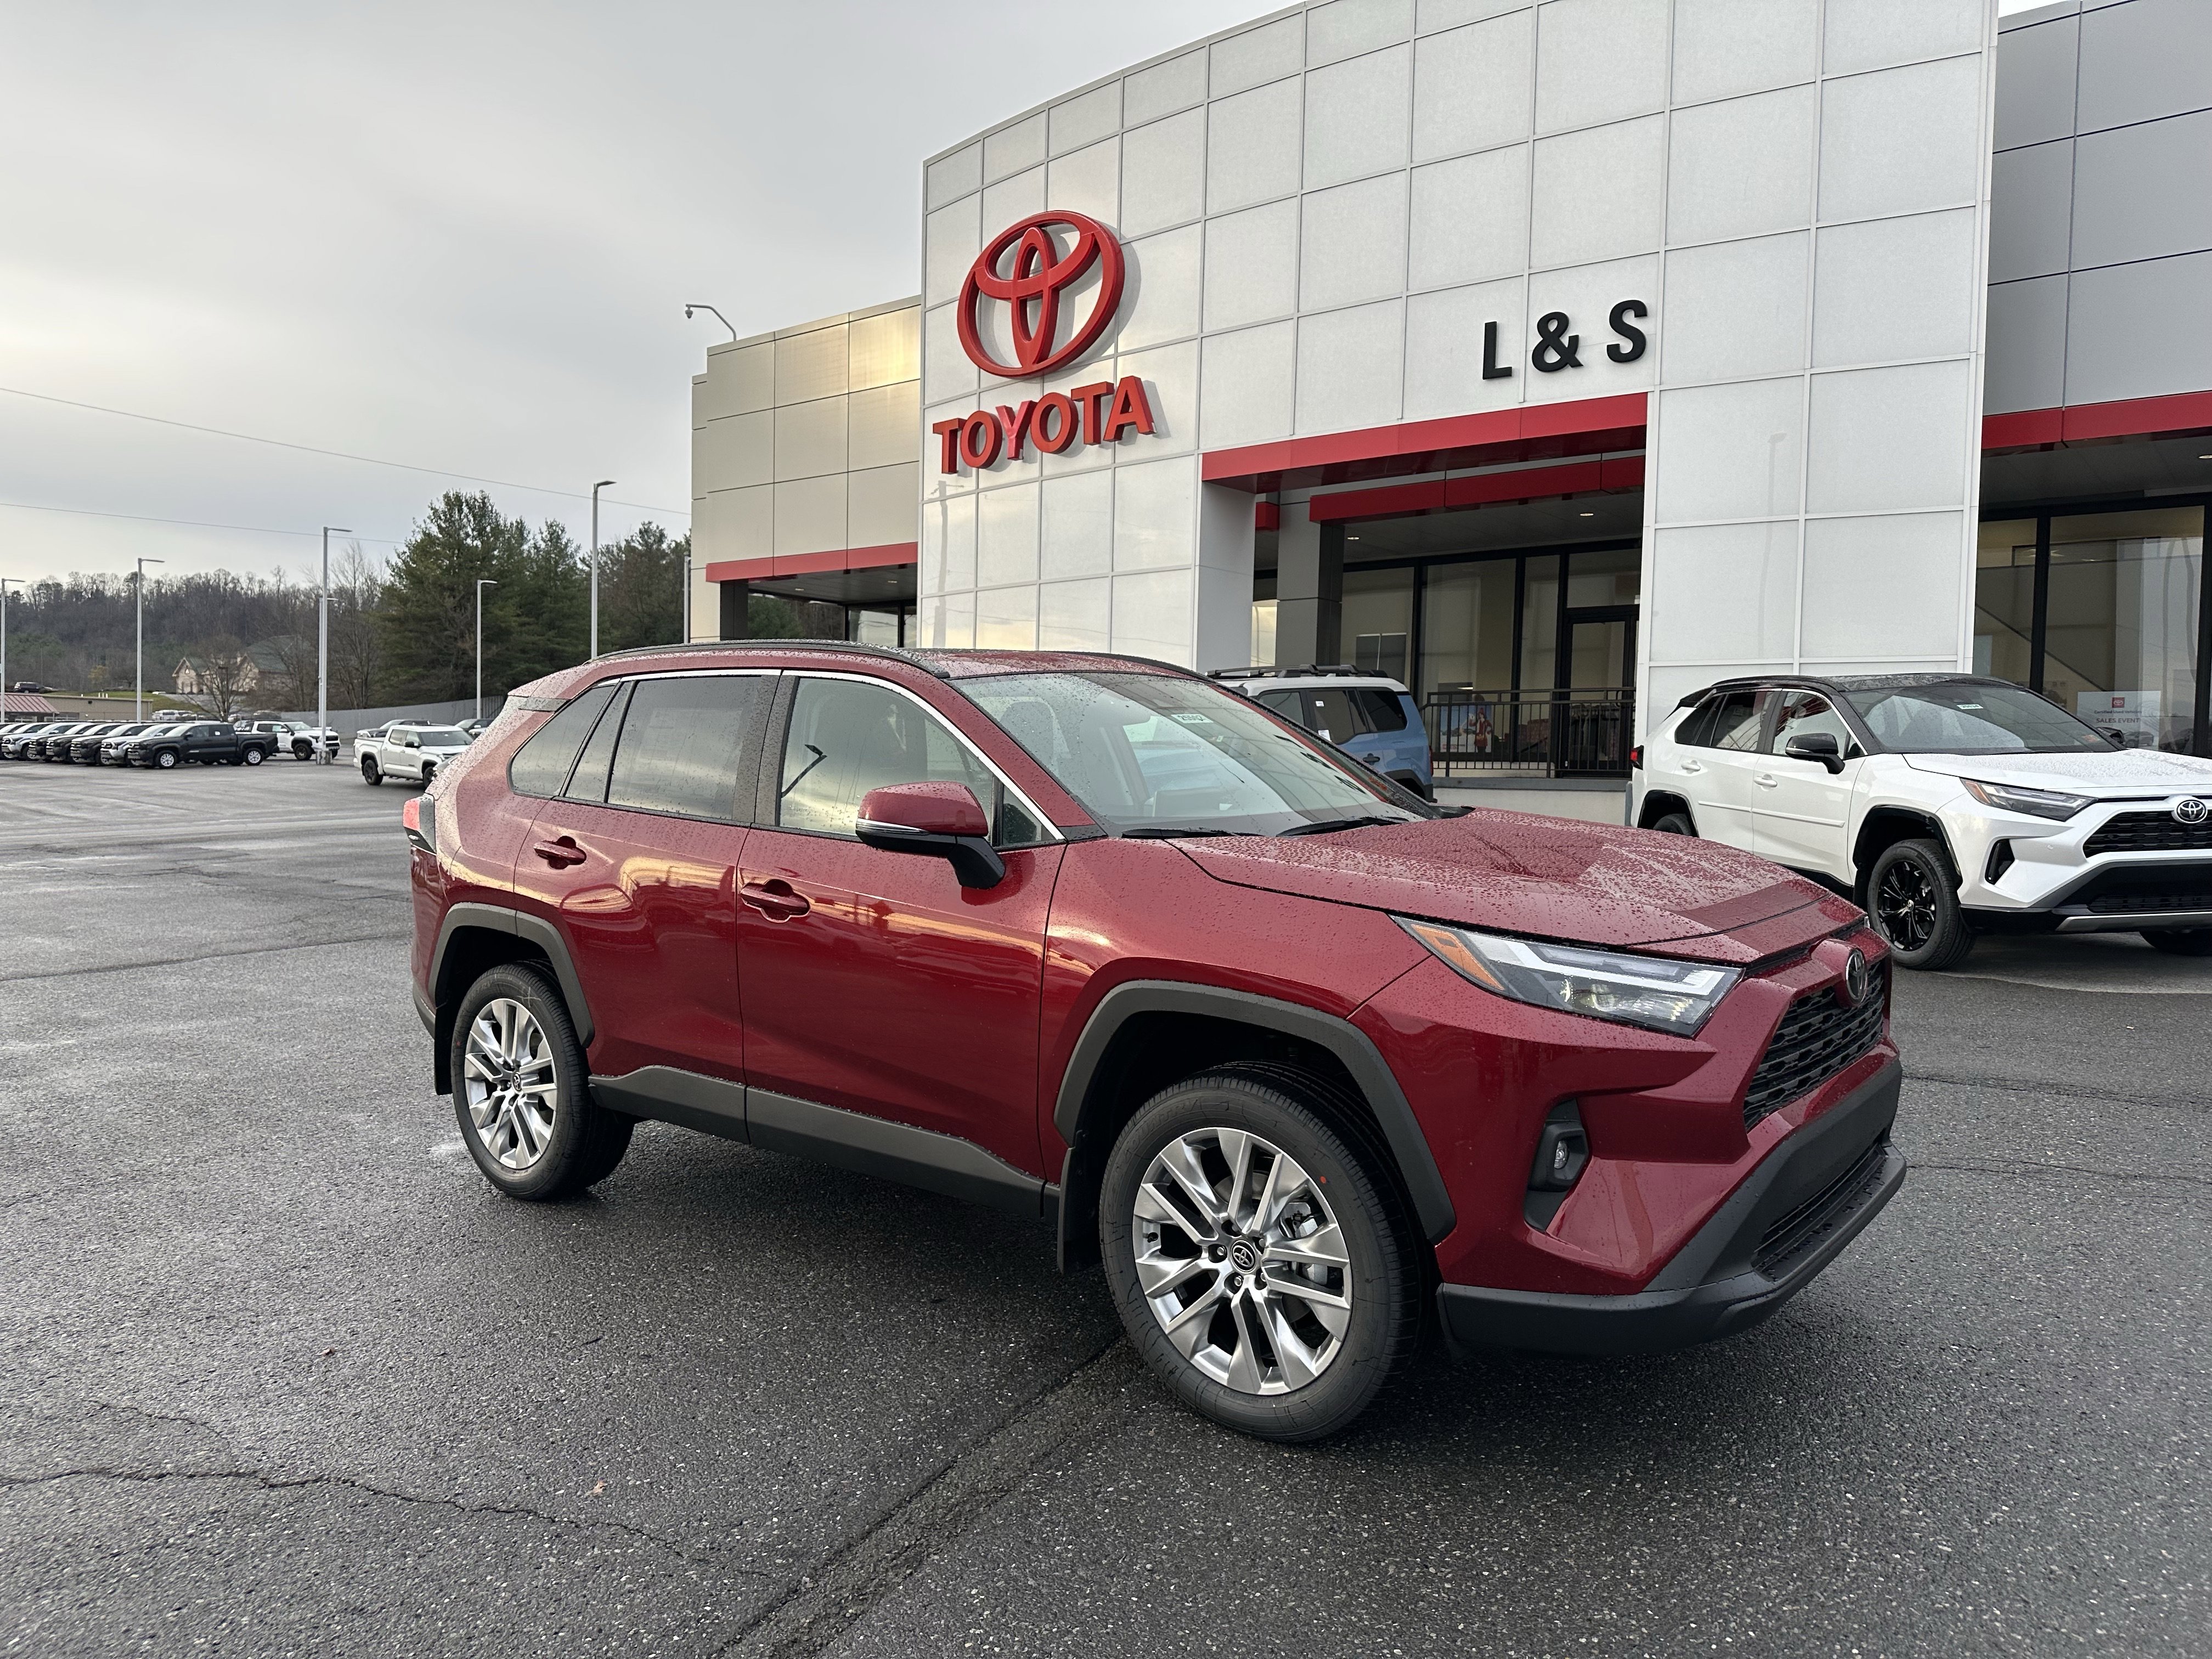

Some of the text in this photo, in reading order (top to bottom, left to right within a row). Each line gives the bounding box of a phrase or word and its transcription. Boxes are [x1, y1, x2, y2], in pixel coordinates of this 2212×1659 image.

[1482, 300, 1647, 380] L & S
[933, 375, 1156, 474] TOYOTA
